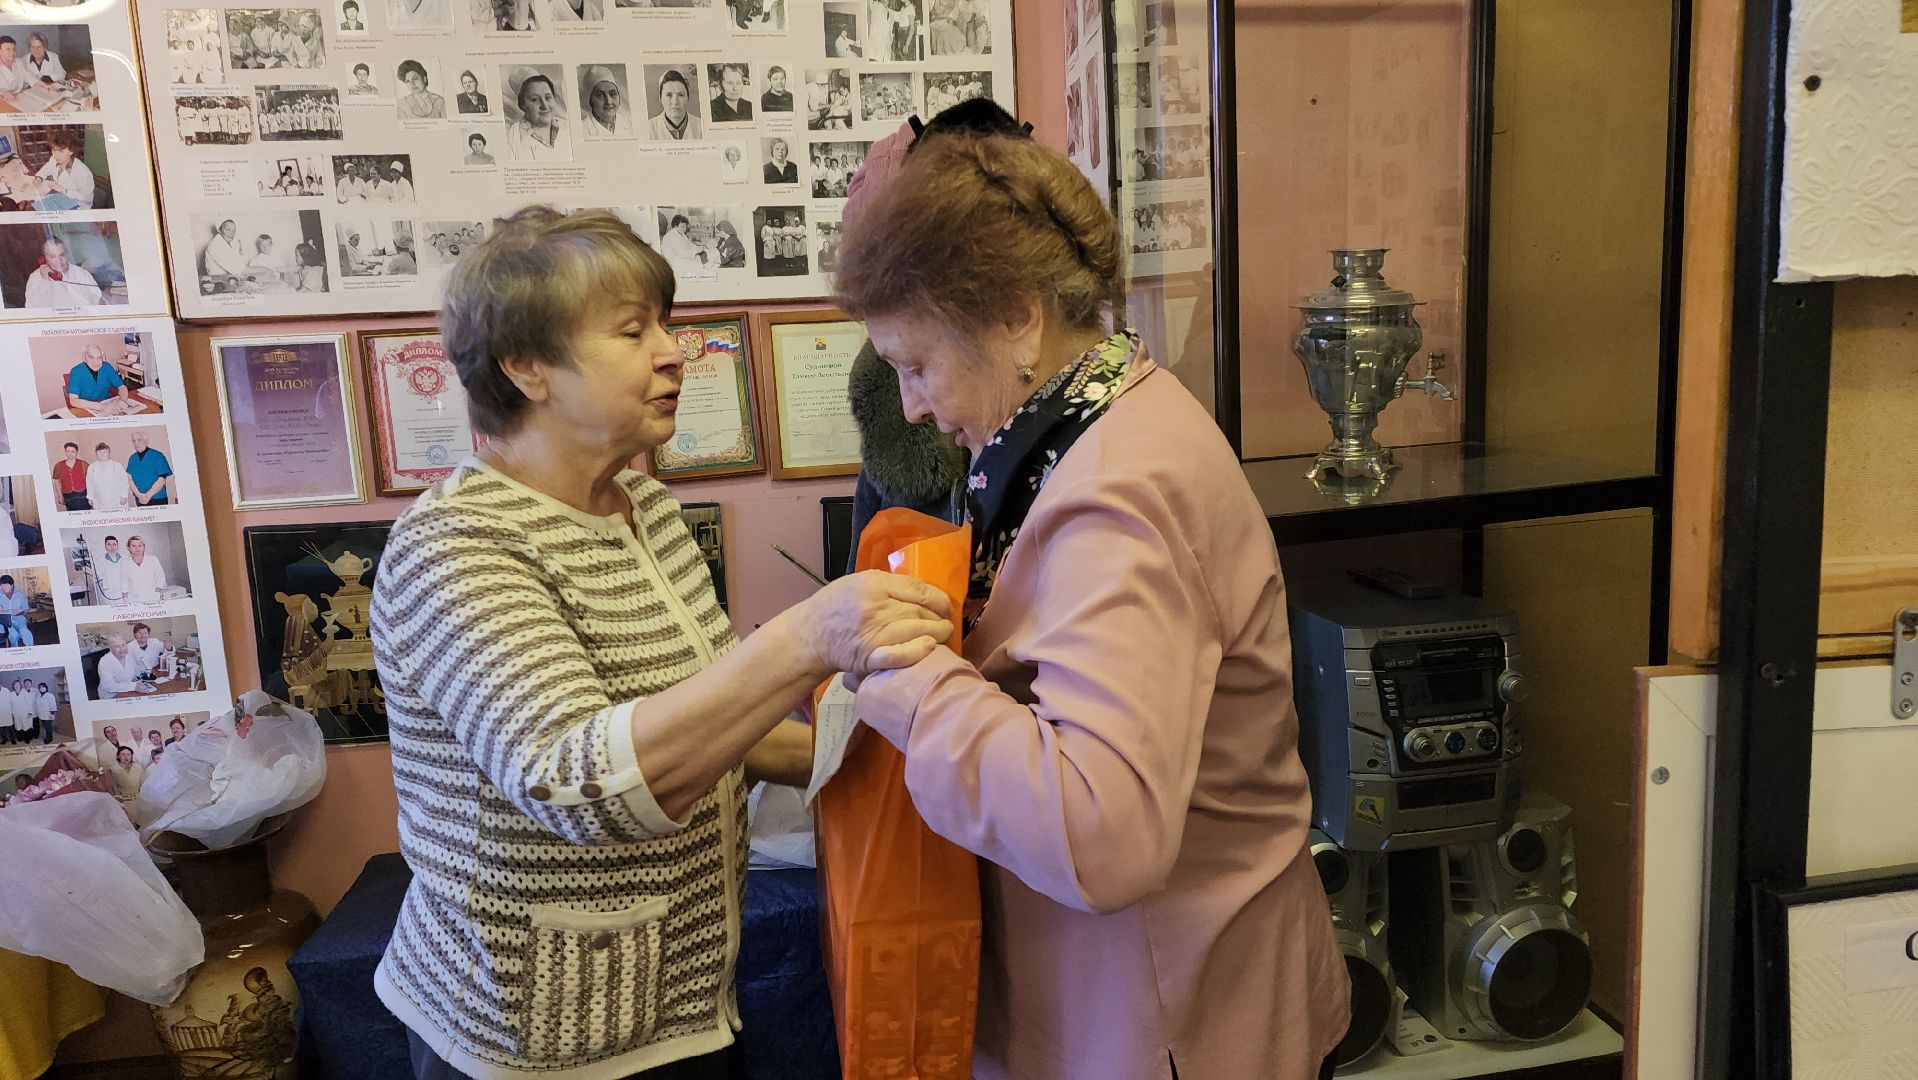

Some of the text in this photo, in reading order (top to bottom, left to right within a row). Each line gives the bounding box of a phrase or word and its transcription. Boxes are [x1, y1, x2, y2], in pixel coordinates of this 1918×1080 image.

[403, 347, 444, 361] ДИПЛОМ
[683, 363, 717, 374] АМОТА
[255, 379, 314, 391] ДИПЛОМ
[112, 610, 167, 620] ЛАБОРАТОРИЯ
